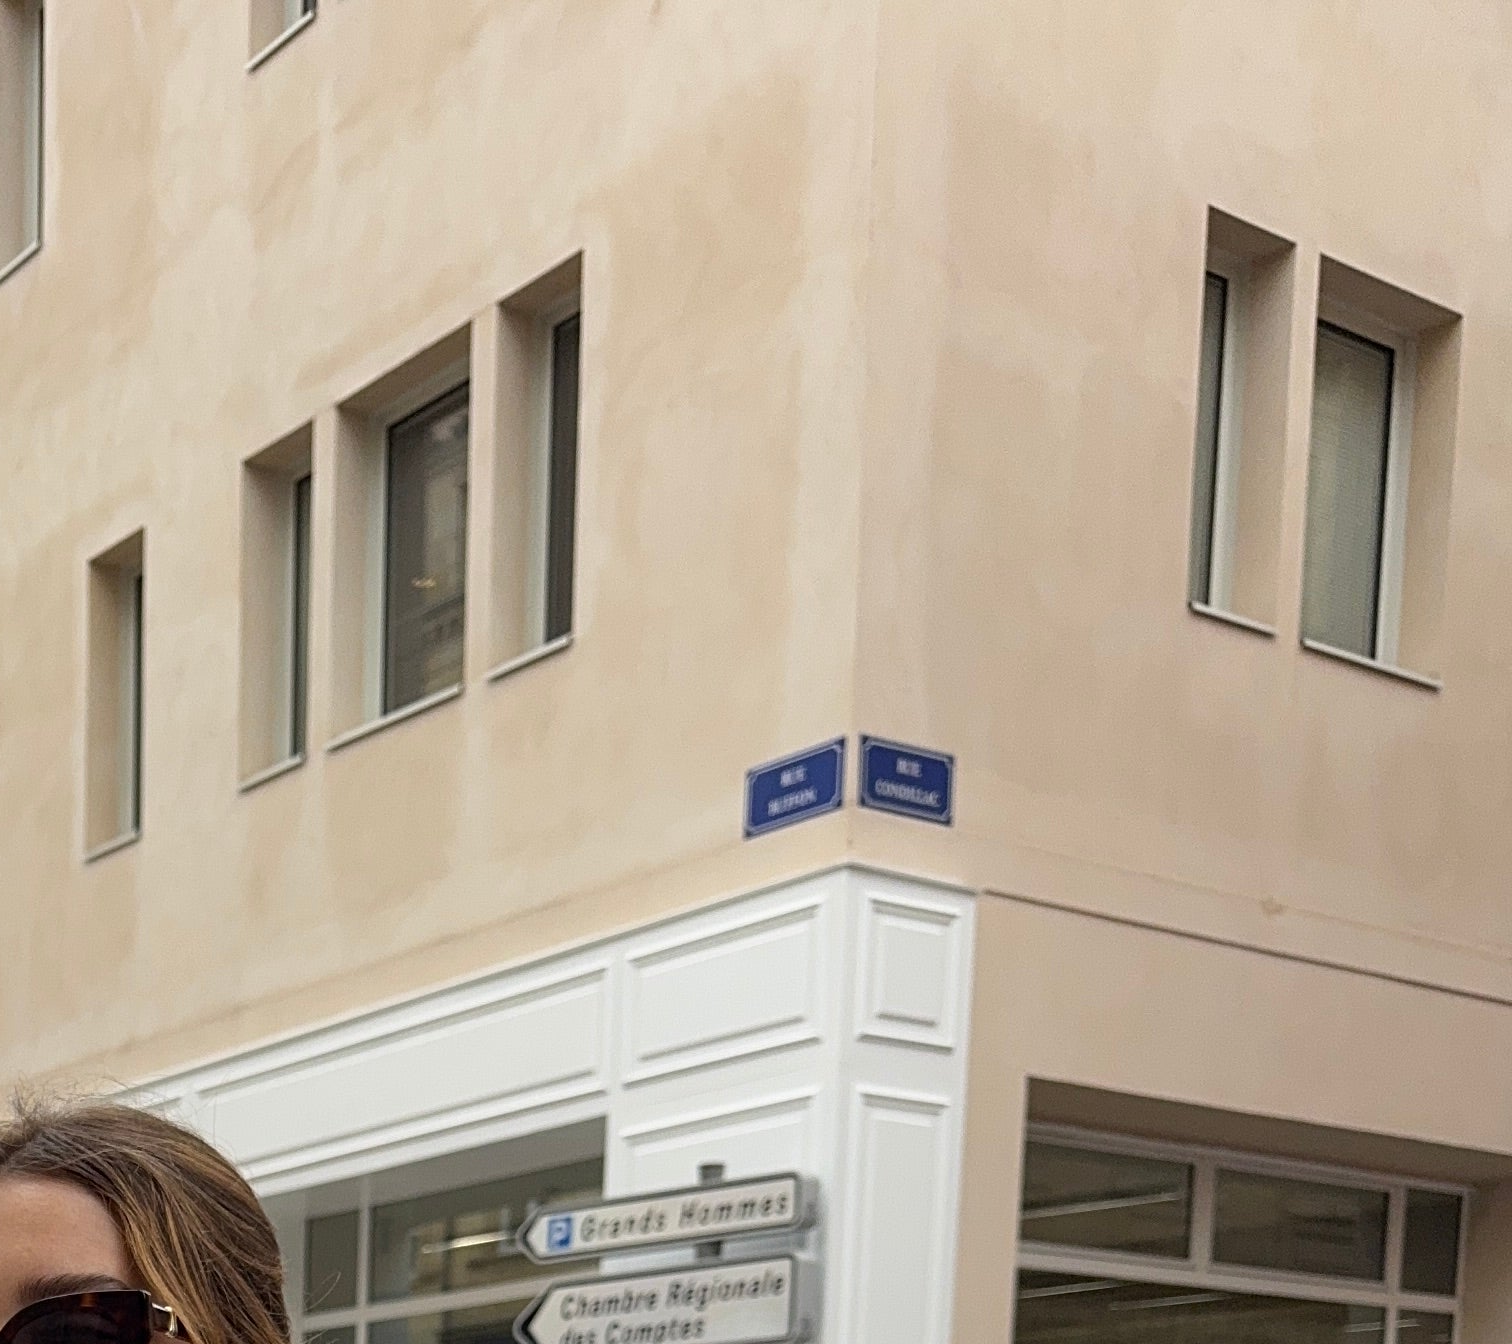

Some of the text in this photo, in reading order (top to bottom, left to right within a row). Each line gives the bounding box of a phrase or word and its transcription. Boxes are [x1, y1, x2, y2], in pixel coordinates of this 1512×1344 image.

[580, 1205, 666, 1242] Grands
[678, 1192, 788, 1228] Hommes
[560, 1269, 786, 1321] Chambre Régionale
